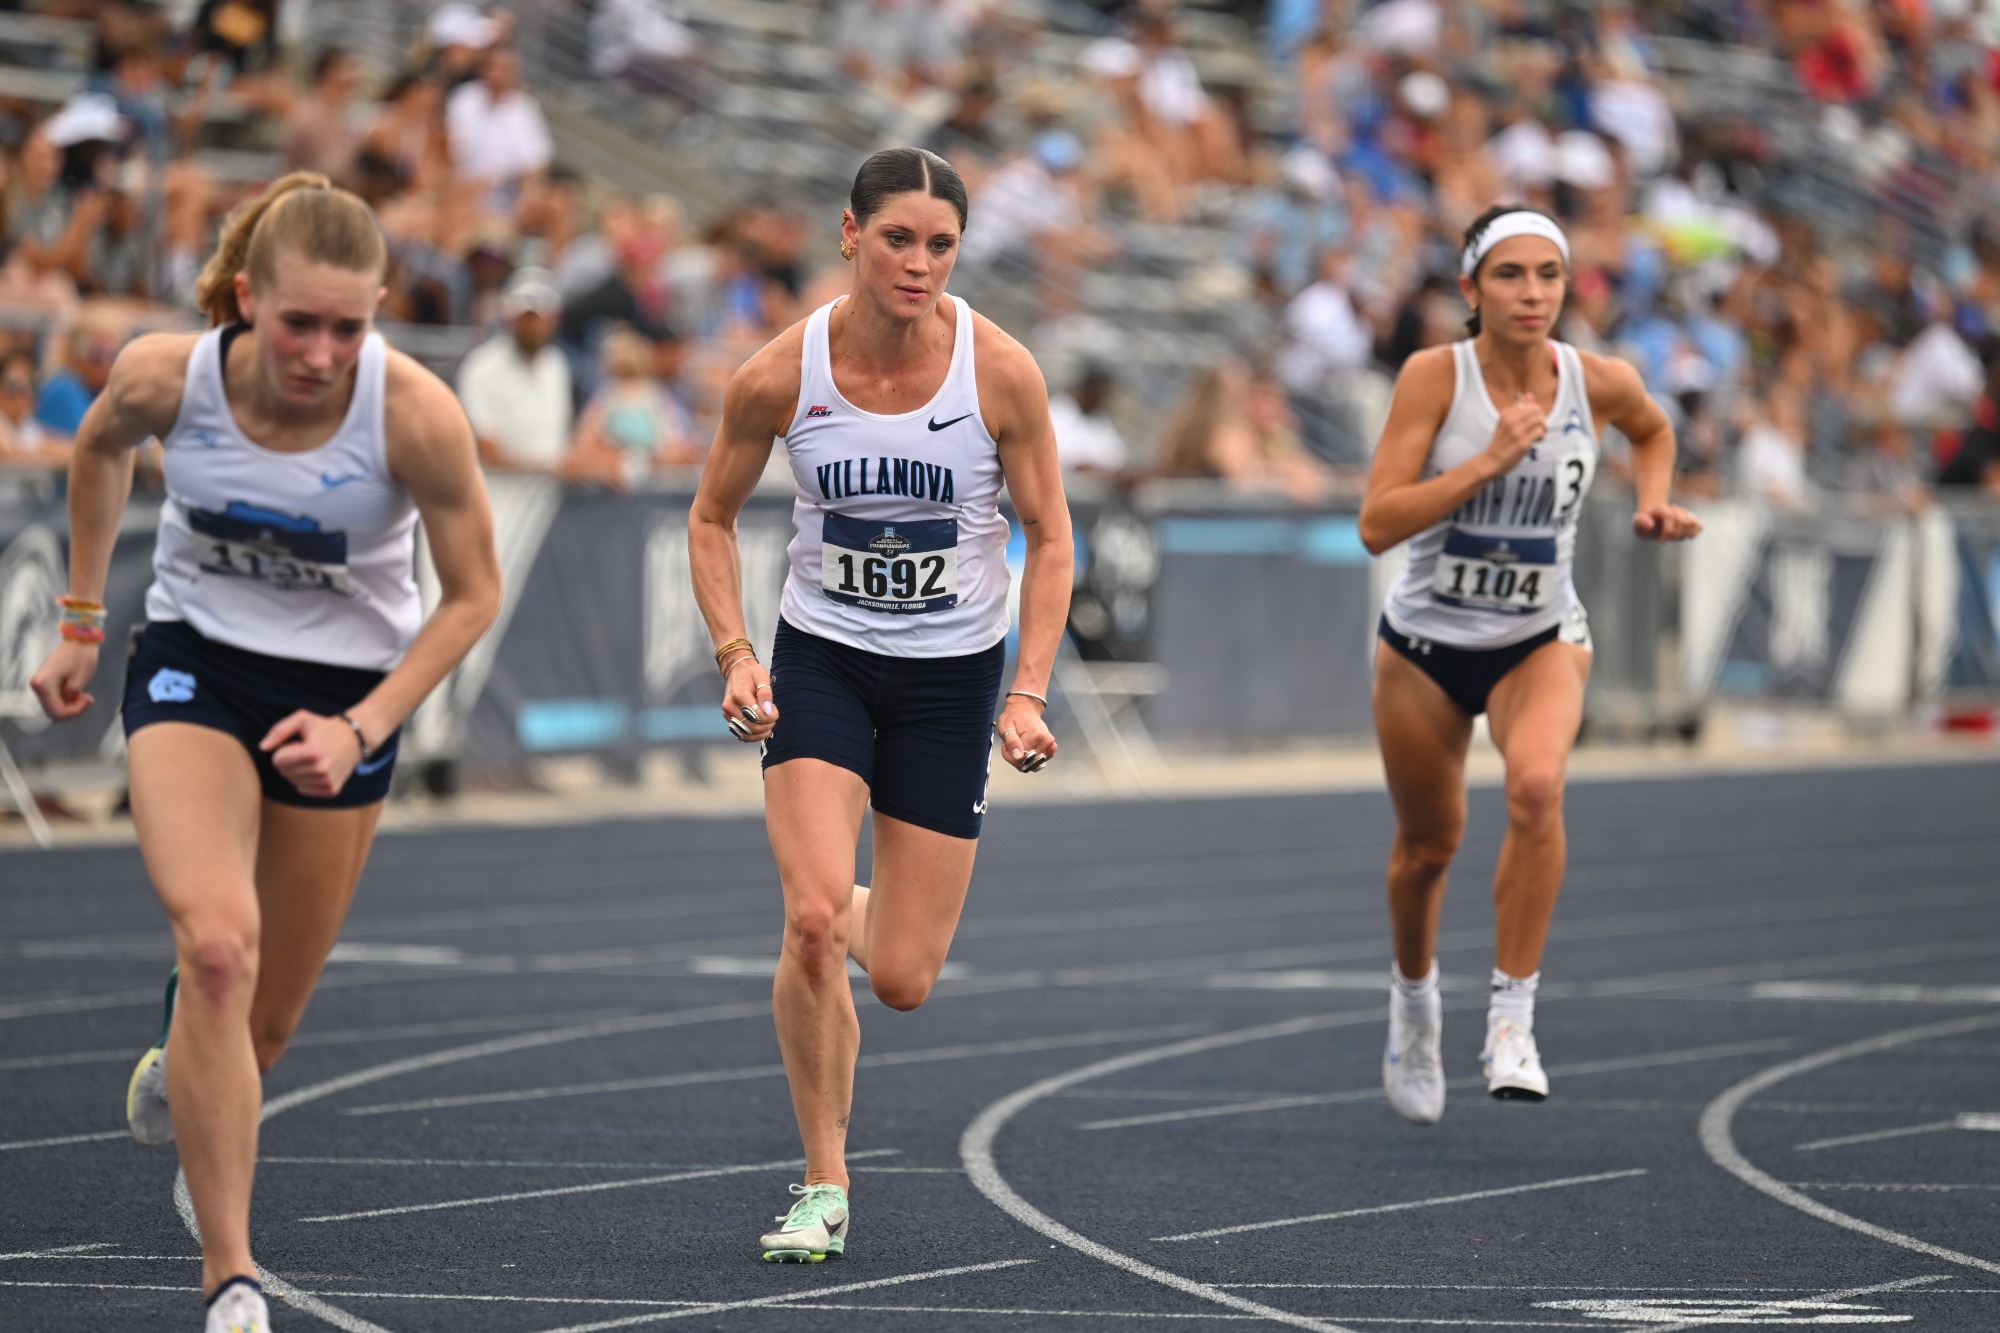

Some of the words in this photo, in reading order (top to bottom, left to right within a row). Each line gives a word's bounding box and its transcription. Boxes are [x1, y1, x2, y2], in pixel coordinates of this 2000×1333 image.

[816, 456, 954, 504] VILLANOVA
[1561, 458, 1584, 512] 3
[838, 553, 947, 599] 1692
[1449, 563, 1541, 602] 1104
[901, 601, 926, 610] FLORIDA
